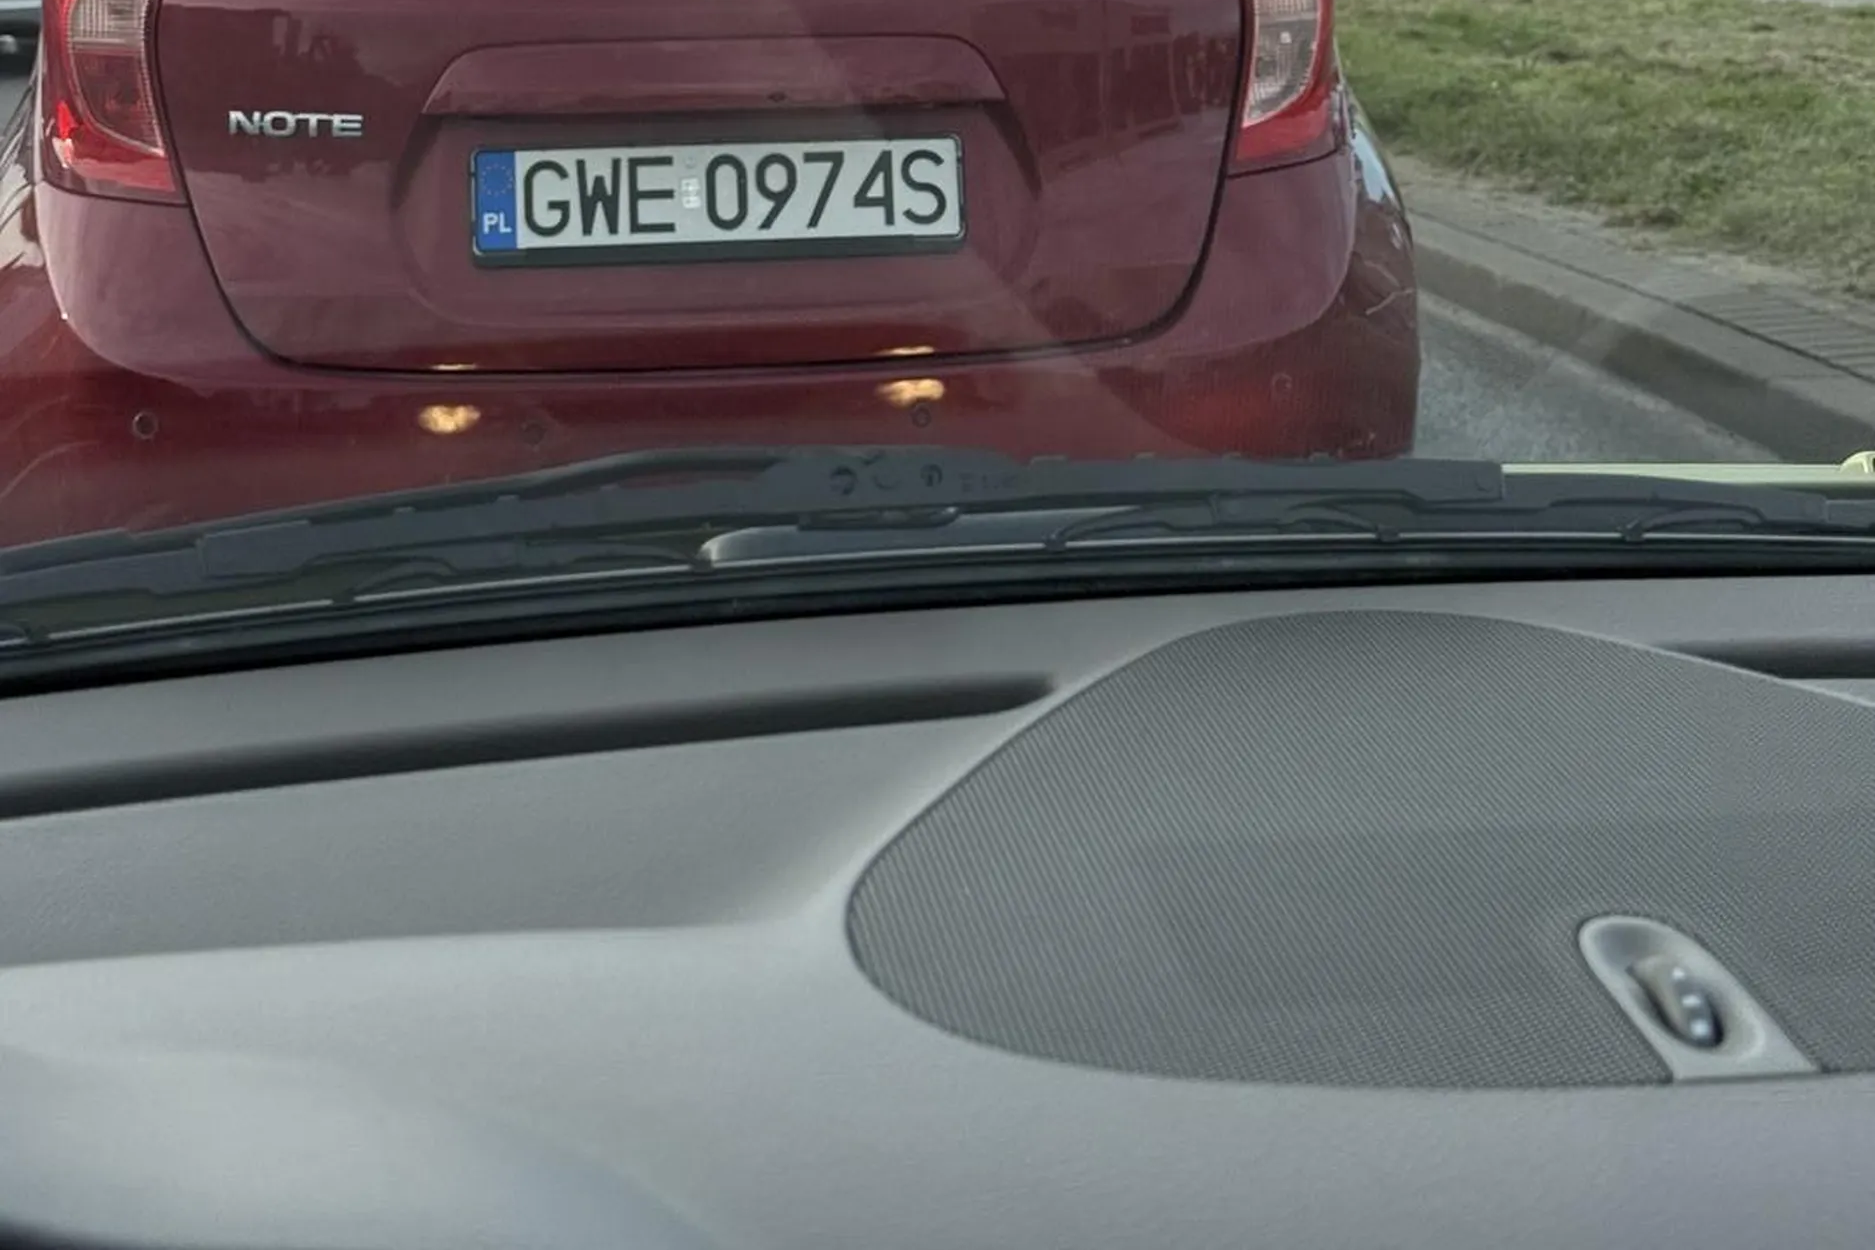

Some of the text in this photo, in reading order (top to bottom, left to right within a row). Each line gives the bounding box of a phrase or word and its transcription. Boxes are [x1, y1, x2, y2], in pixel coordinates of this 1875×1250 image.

[228, 110, 364, 138] NOTE
[523, 149, 947, 238] GWE 0974S
[482, 211, 512, 234] PL
